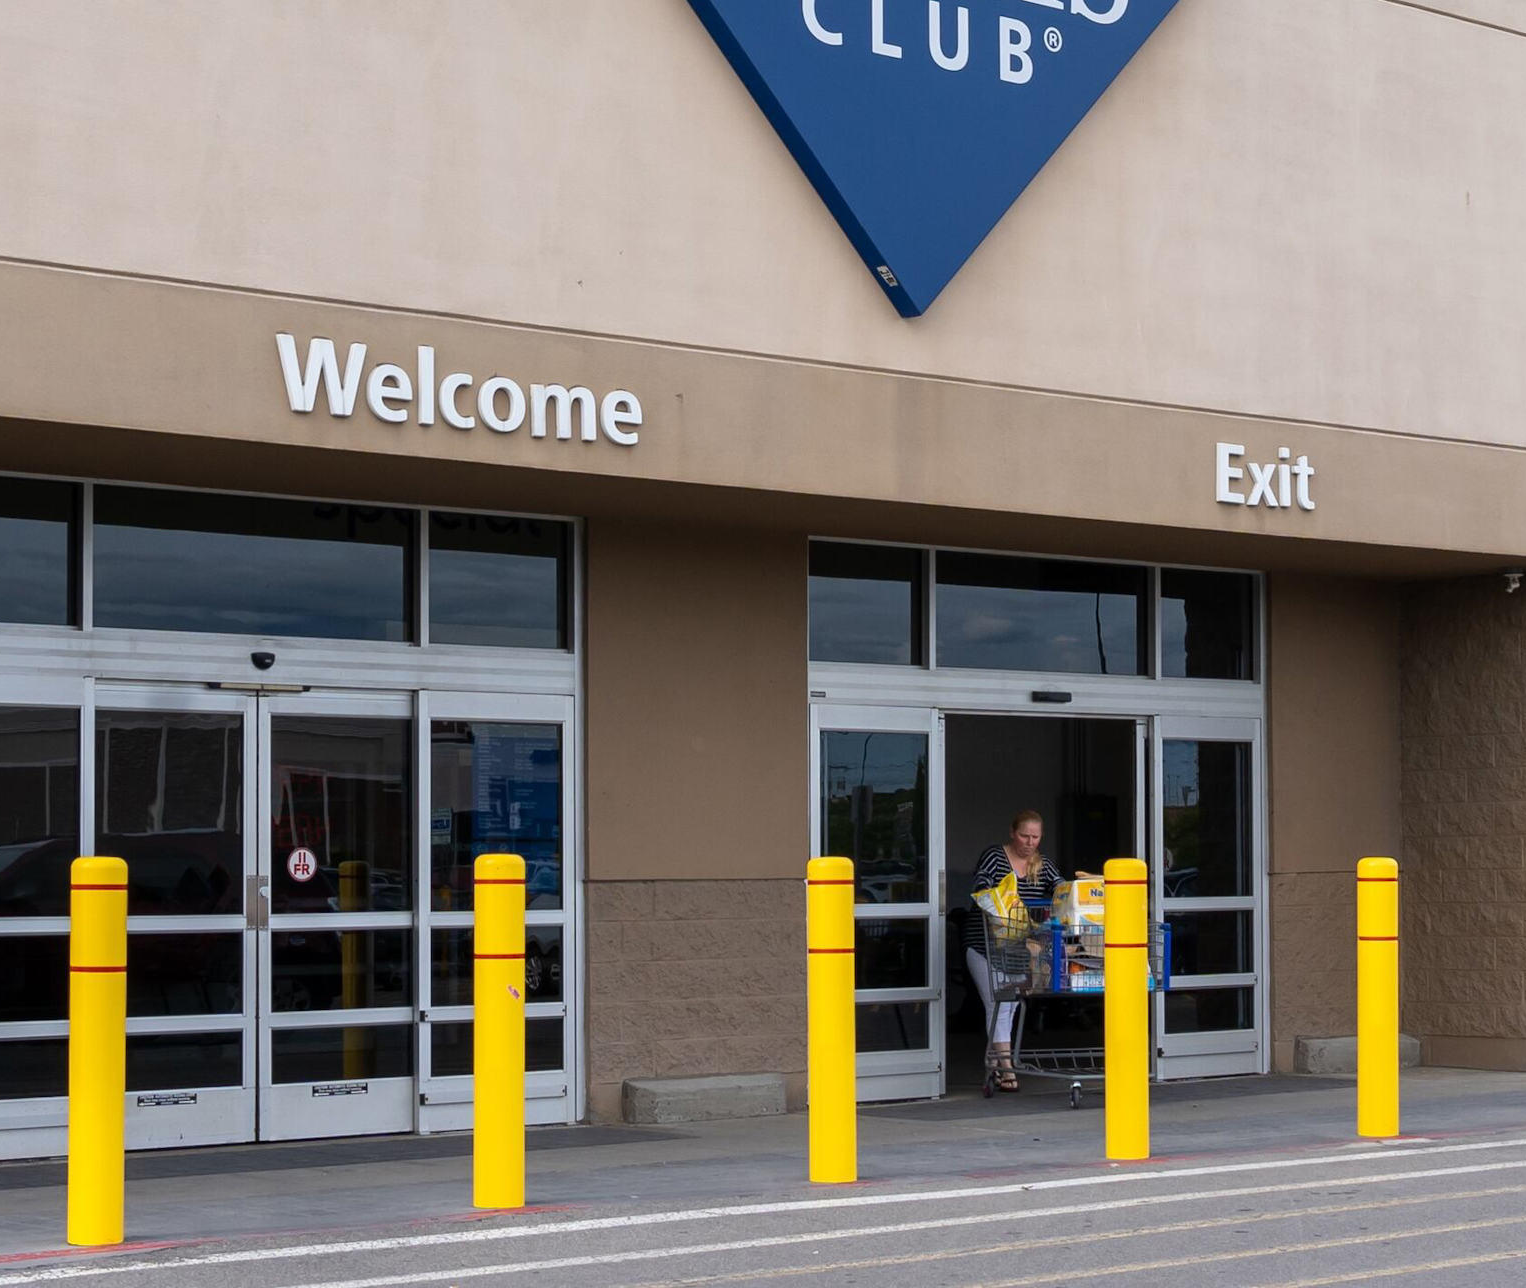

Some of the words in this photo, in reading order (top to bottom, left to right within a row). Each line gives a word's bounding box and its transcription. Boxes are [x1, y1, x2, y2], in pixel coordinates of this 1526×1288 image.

[275, 332, 643, 447] Welcome
[1216, 442, 1315, 511] Exit
[293, 864, 310, 875] FR
